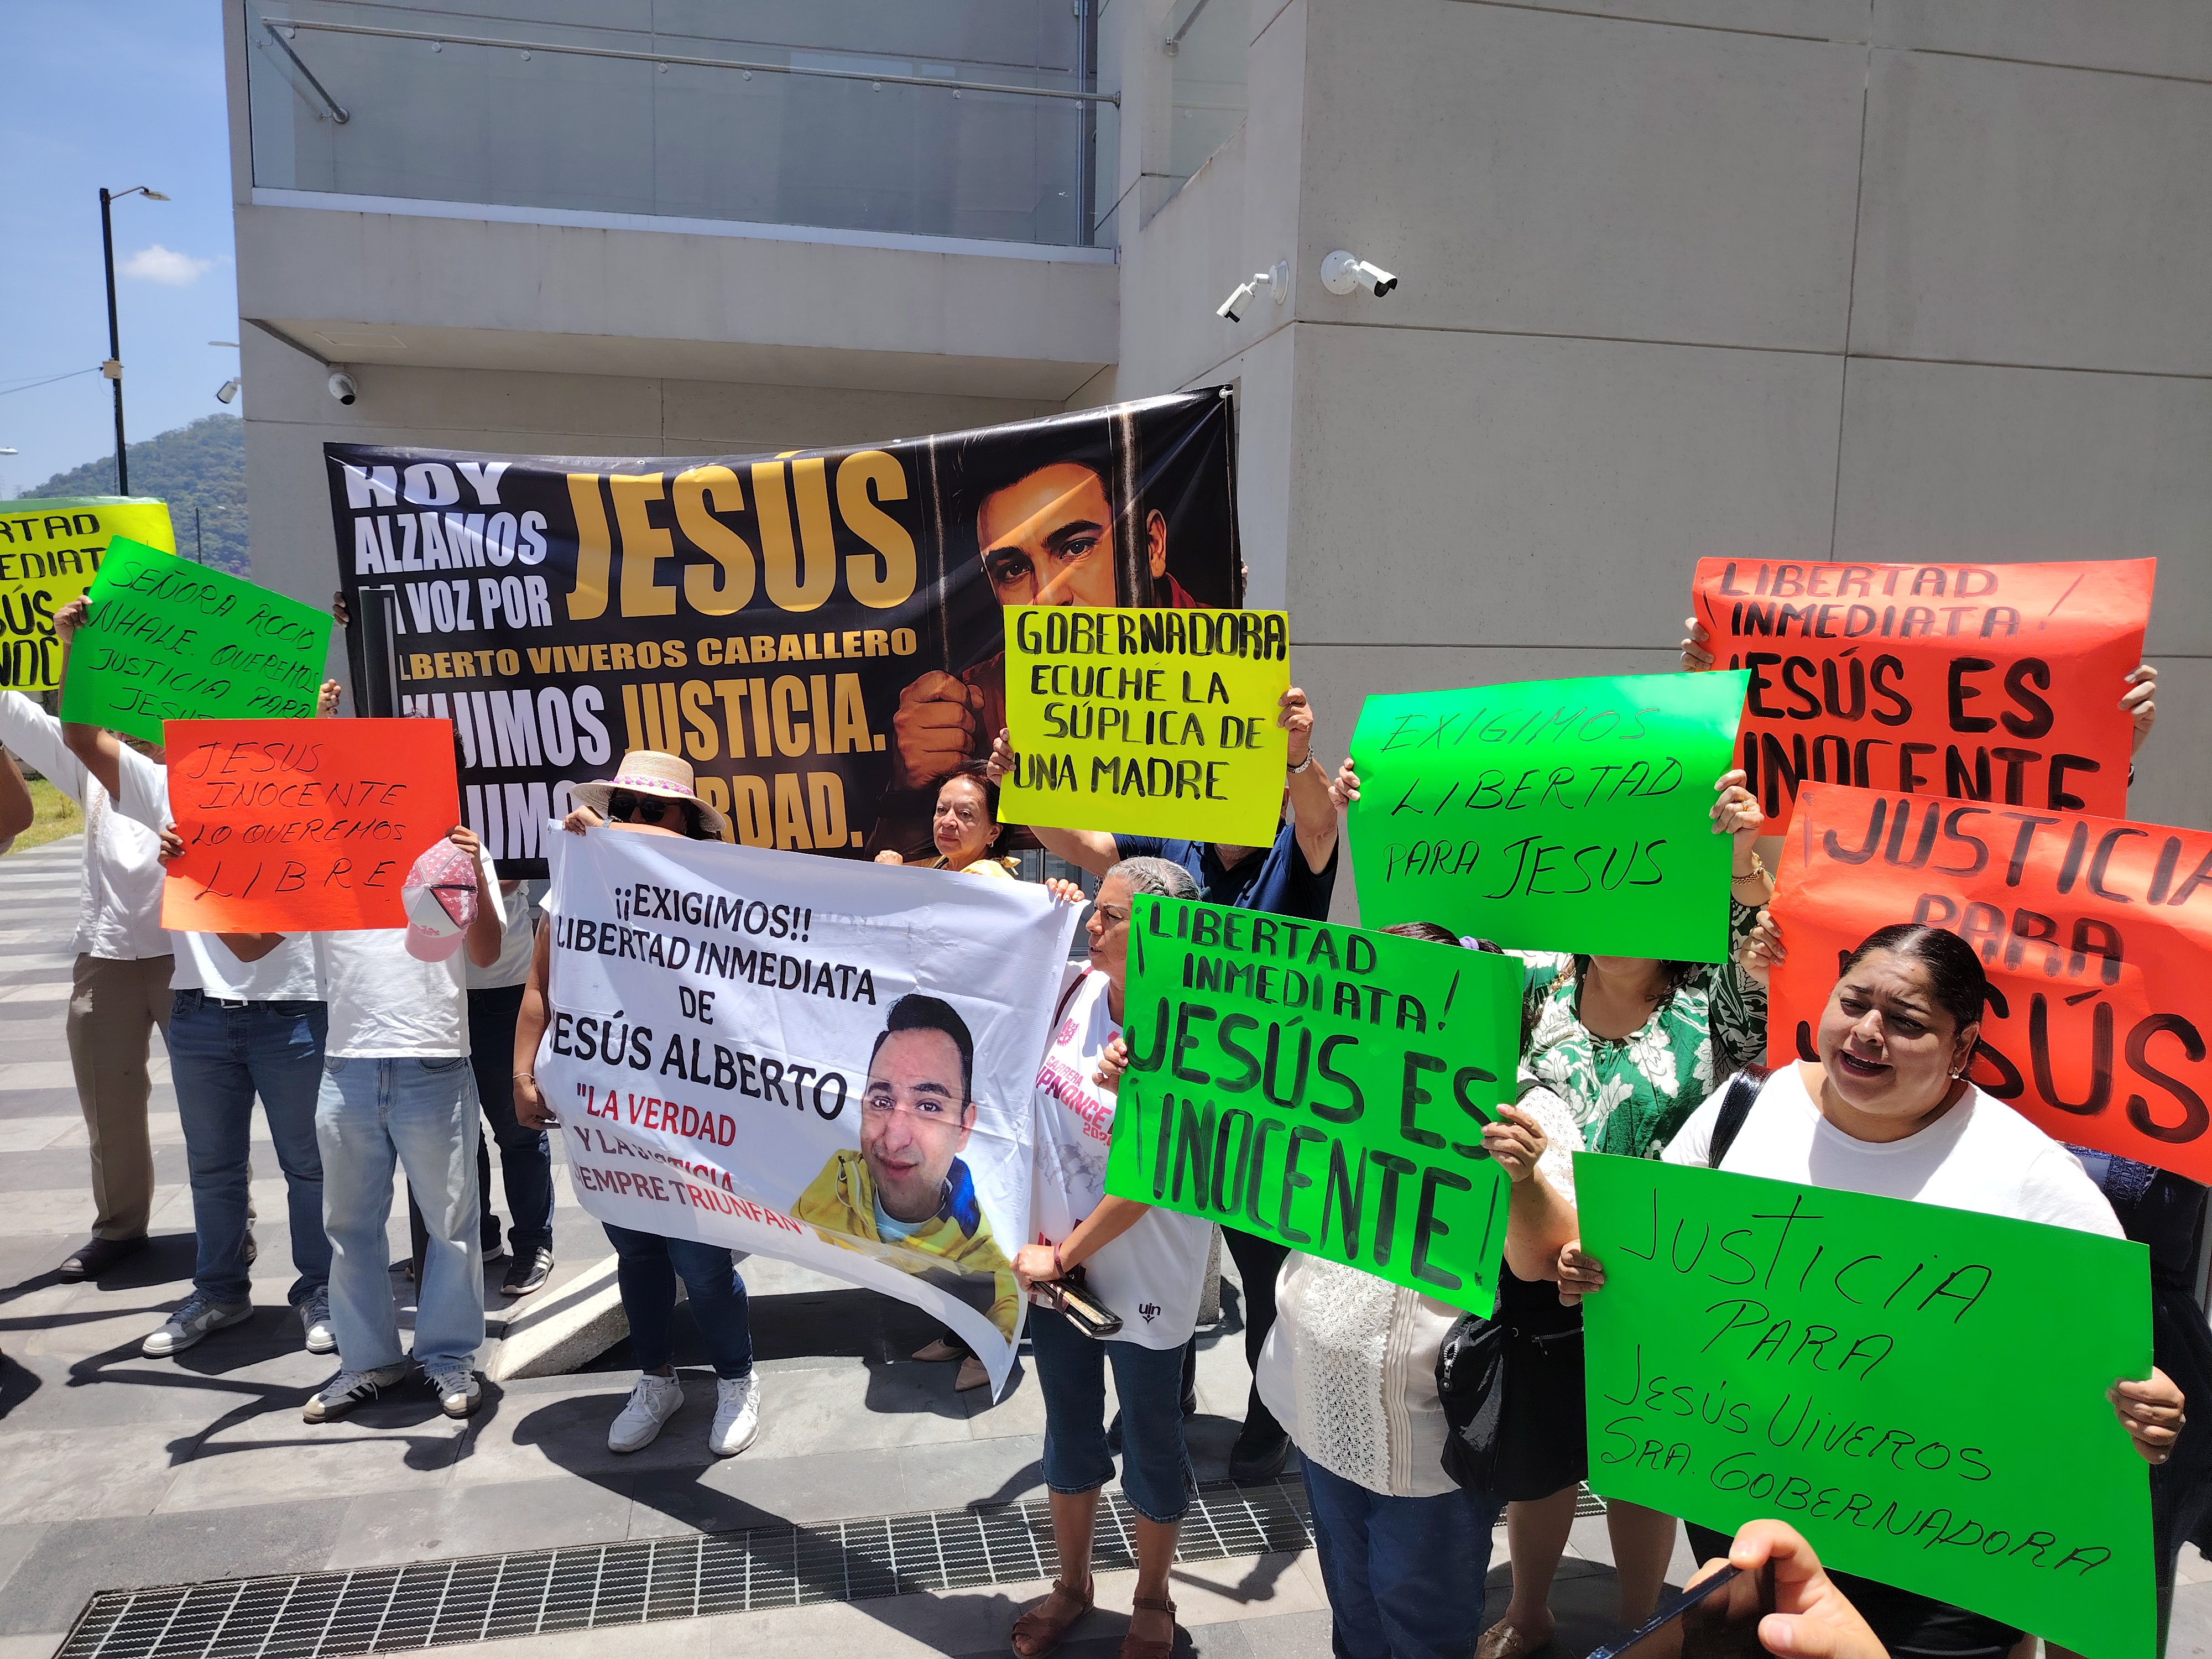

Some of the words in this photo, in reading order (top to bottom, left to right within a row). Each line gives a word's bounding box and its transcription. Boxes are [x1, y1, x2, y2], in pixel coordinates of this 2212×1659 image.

[343, 462, 513, 509] HOY
[354, 511, 547, 575] ALZAMOS
[566, 450, 916, 620] JESÚS
[107, 562, 237, 617] SEÑORA
[406, 579, 475, 633] VOZ
[478, 576, 552, 629] POR
[399, 649, 522, 680] LBERTO
[526, 640, 688, 674] VIVEROS
[697, 628, 916, 666] CABALLERO
[1016, 611, 1287, 661] GOBERNADORA
[88, 649, 231, 698] JUSTICIA
[210, 645, 319, 693] QUEREMOS
[1031, 662, 1166, 702] ECUCHÉ
[1182, 670, 1230, 705] LA
[1729, 646, 1914, 727] ESÚS
[1947, 656, 2055, 740] ES
[622, 672, 886, 761] JUSTICIA.
[1042, 700, 1206, 747] SÚPLICA
[1220, 714, 1266, 750] DE
[1379, 706, 1660, 754] EXIGIMOS
[187, 742, 324, 779] JESUS
[1013, 752, 1078, 792] UNA
[1091, 755, 1230, 801] MADRE
[1391, 757, 1683, 817] LIBERTAD
[199, 780, 408, 808] INOCENTE
[695, 772, 863, 849] RDAD.
[192, 823, 231, 846] LO
[243, 818, 406, 844] QUEREMOS
[194, 857, 396, 900] LIBRE
[1383, 839, 1480, 883] PARA
[1481, 836, 1668, 899] JESUS
[615, 883, 812, 942] ¡¡EXIGIMOS!!
[557, 915, 690, 970] LIBERTAD
[695, 941, 877, 1005] INMEDIATA
[679, 985, 715, 1025] DE
[1182, 952, 1460, 1034] INMEDIATA!
[550, 1009, 653, 1071] ESÚS
[660, 1034, 848, 1121] ALBERTO
[1046, 1055, 1084, 1087] CARRERA
[1126, 997, 1365, 1124] JESÚS
[1400, 1051, 1499, 1161] ES
[573, 1125, 591, 1152] Y
[596, 1129, 636, 1157] LA
[577, 1082, 619, 1121] "LA
[628, 1093, 737, 1147] VERDAD
[1700, 1299, 1894, 1382] PARA
[1604, 1343, 1751, 1434] JESÚS
[1710, 1452, 2112, 1576] GOBERNADORA
